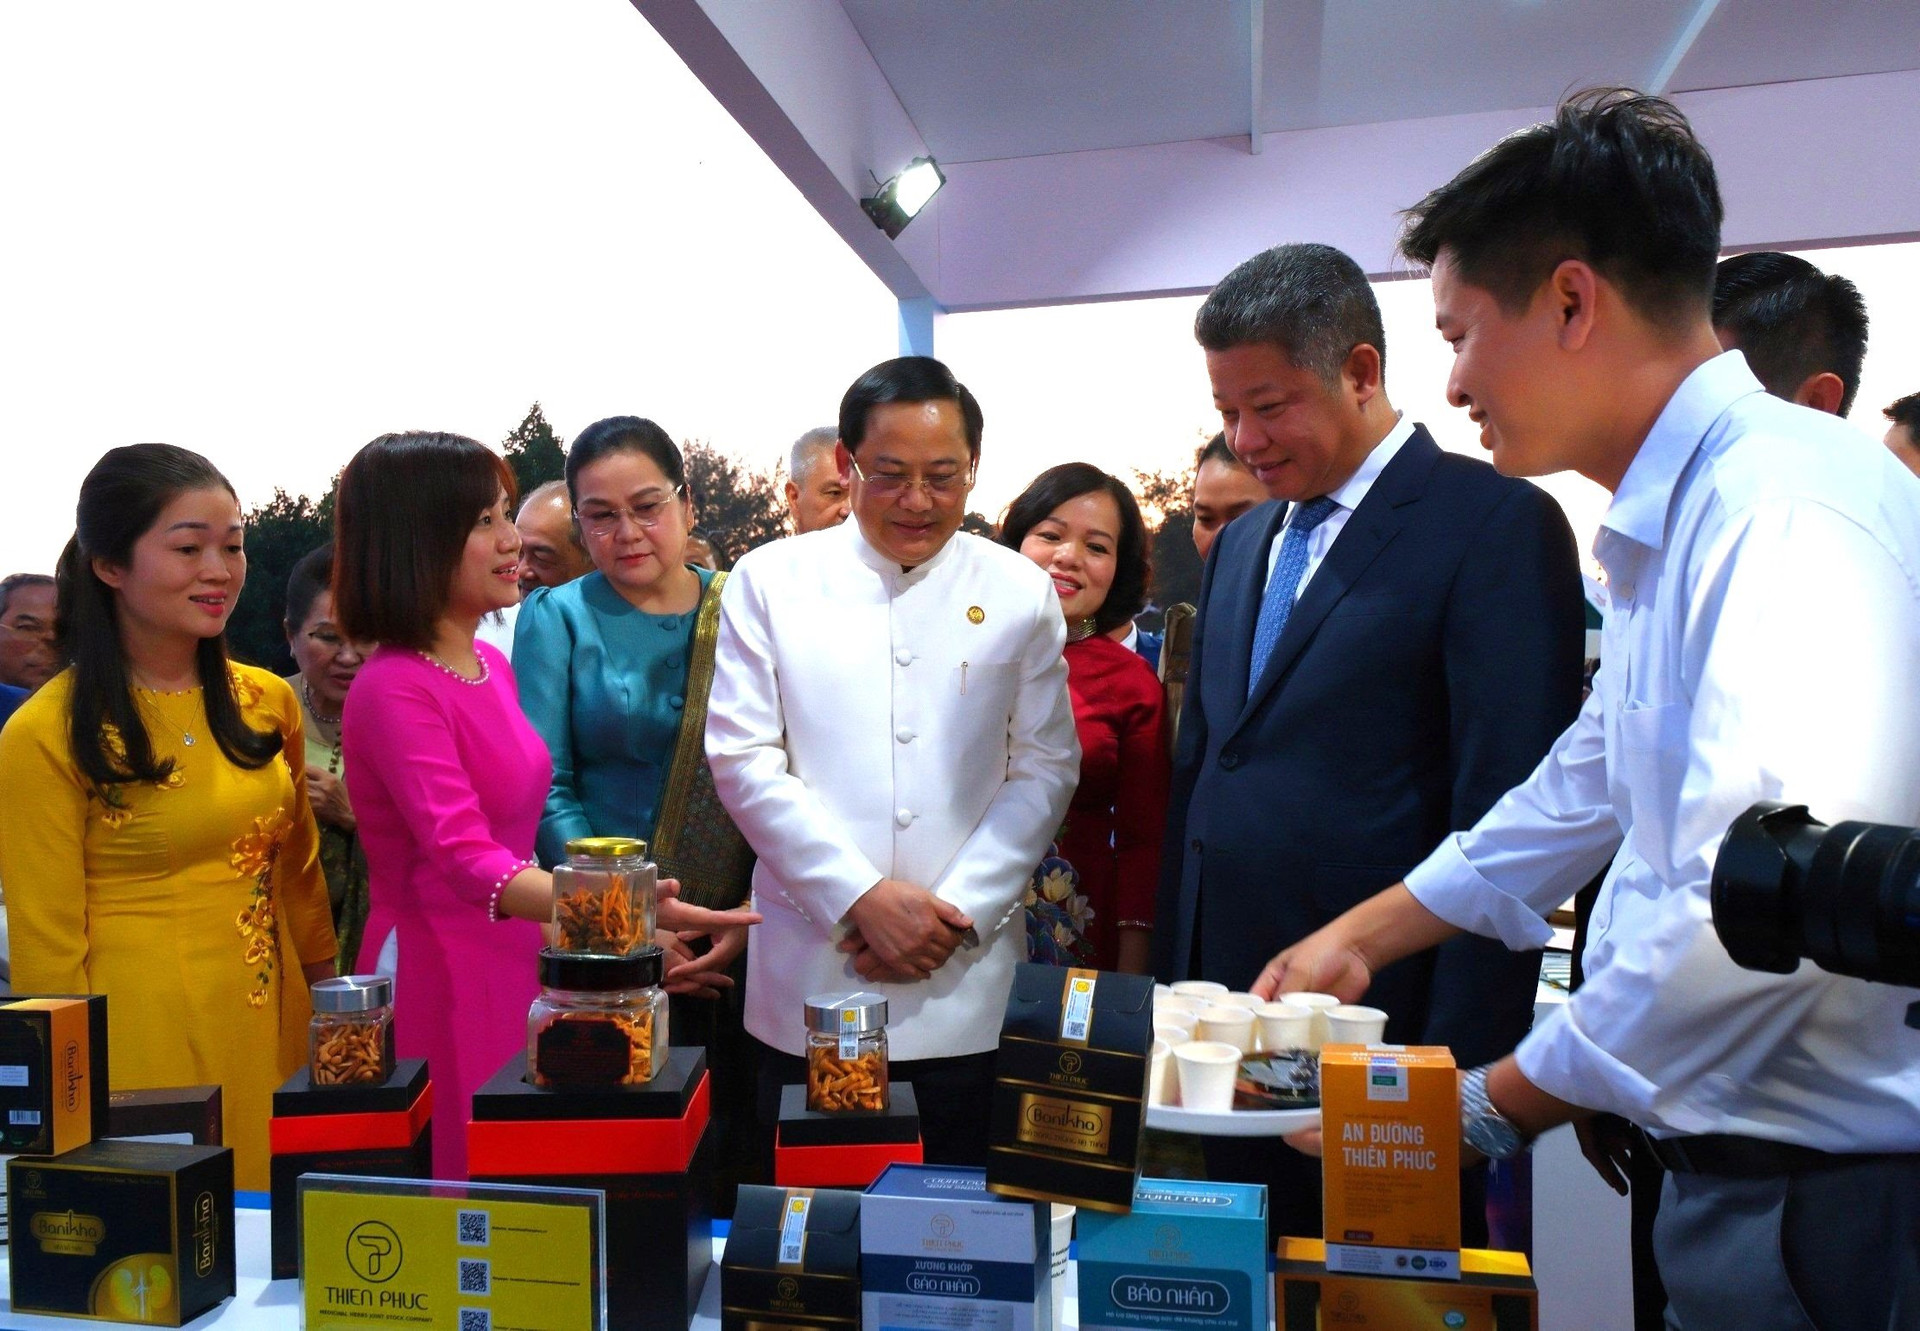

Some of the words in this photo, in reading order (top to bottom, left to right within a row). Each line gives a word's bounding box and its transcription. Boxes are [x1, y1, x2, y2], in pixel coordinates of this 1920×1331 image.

[67, 1046, 84, 1107] Banikha
[1034, 1104, 1095, 1131] Banikha
[1342, 1122, 1364, 1142] AN
[1342, 1145, 1387, 1168] THIÊN
[1393, 1148, 1437, 1171] PHÚC
[38, 1210, 98, 1238] Banikha
[191, 1198, 211, 1270] Banikha
[915, 1260, 946, 1271] XƯƠNG
[948, 1261, 973, 1272] KHỚP
[914, 1275, 938, 1290] BẢO
[940, 1278, 973, 1293] NHÂN
[1127, 1282, 1162, 1303] BẢO
[1166, 1286, 1214, 1307] NHÂN
[324, 1286, 373, 1306] THIEN
[379, 1290, 429, 1311] PHUC
